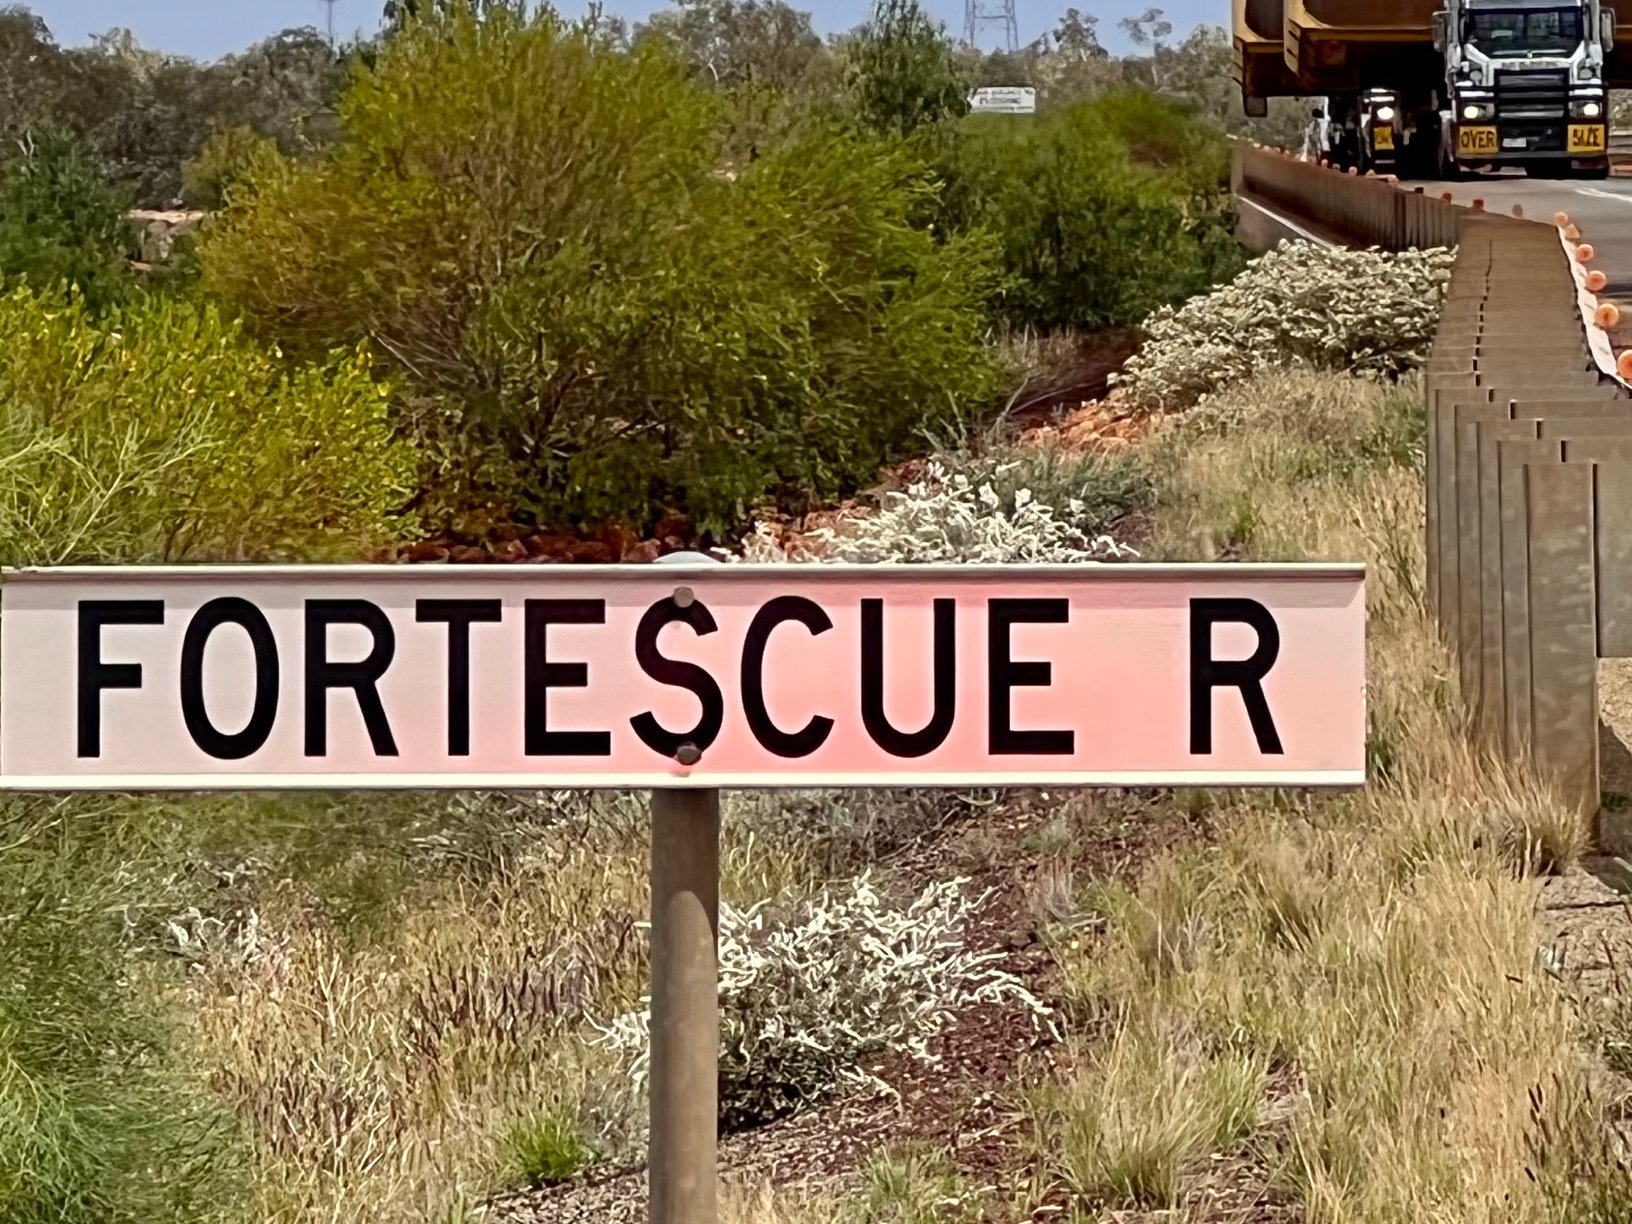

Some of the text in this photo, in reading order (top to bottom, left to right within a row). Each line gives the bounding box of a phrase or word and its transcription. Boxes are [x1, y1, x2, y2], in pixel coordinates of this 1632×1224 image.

[1460, 129, 1495, 149] OVER
[1572, 128, 1600, 147] SIZE
[77, 594, 1284, 762] FORTESCUE R
